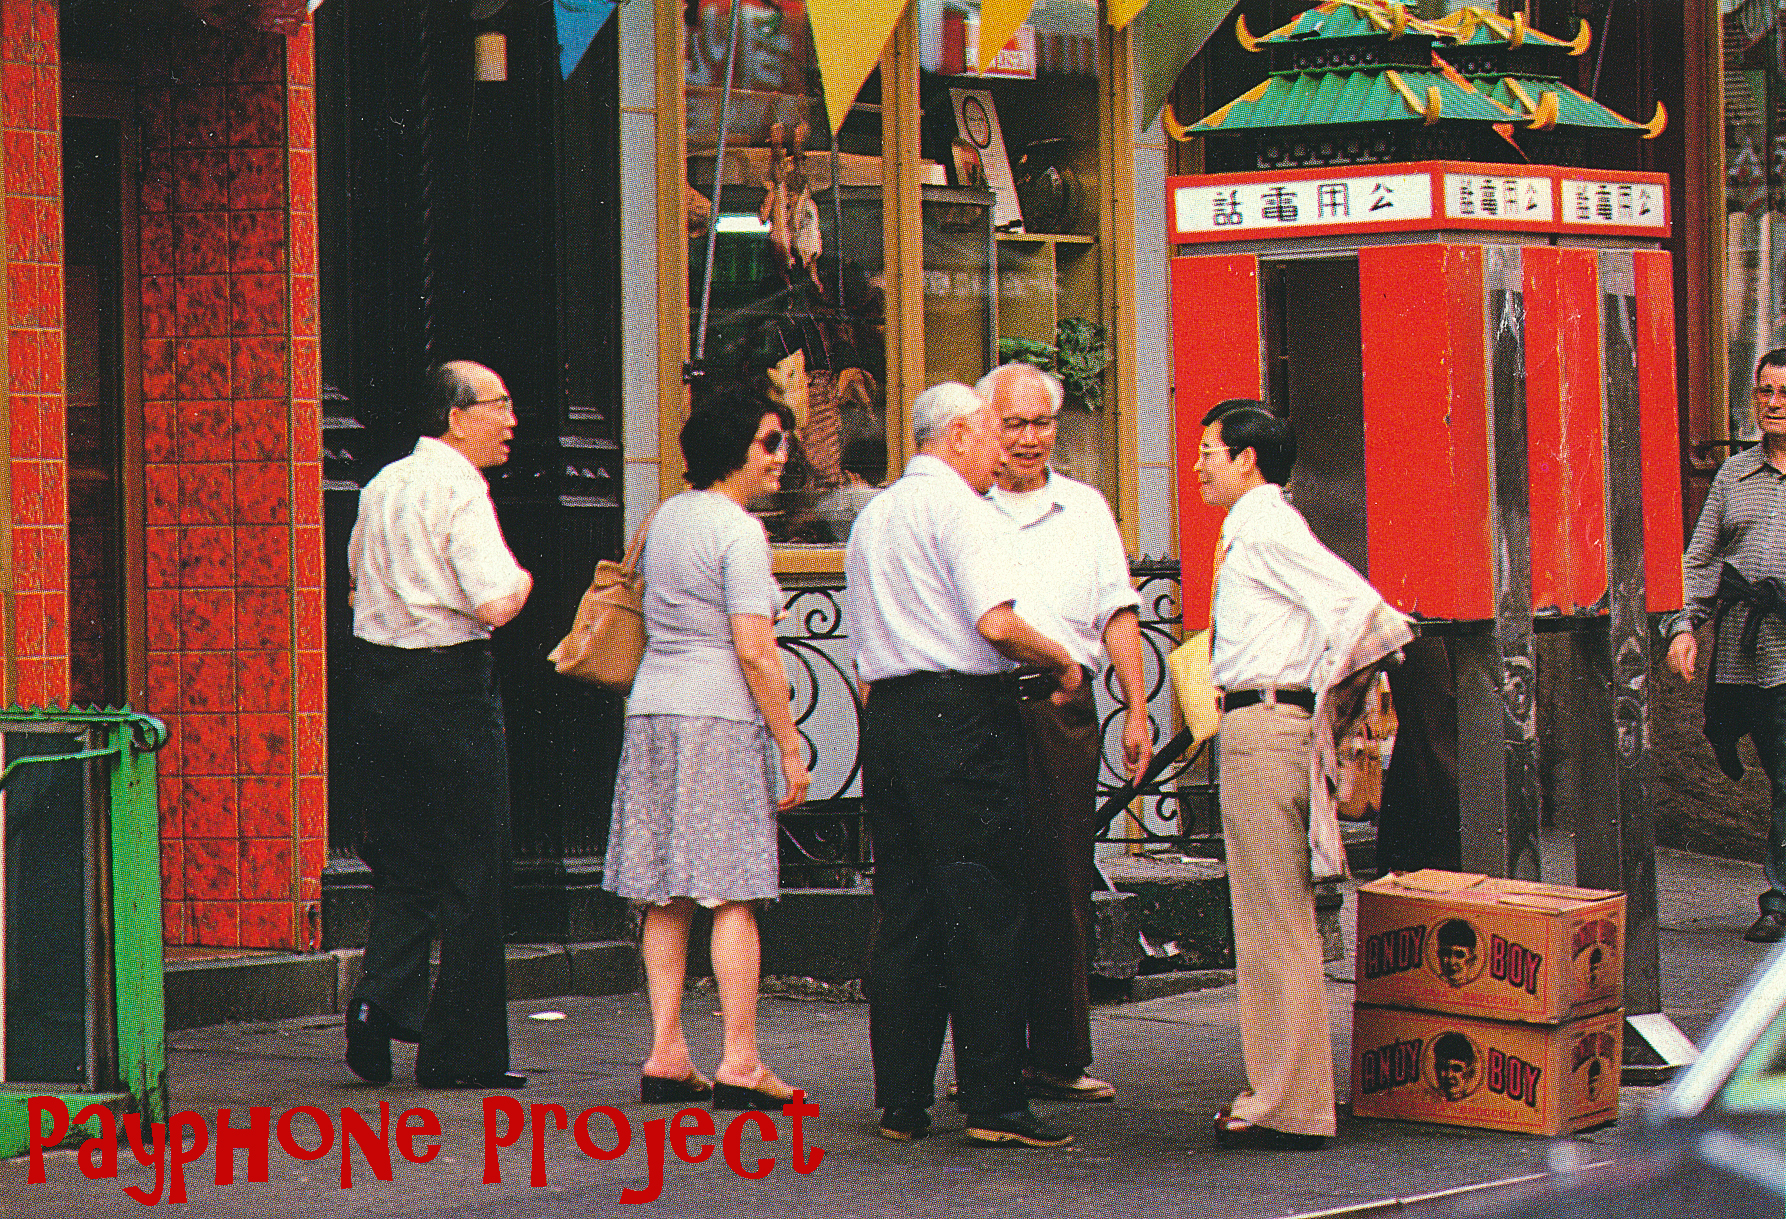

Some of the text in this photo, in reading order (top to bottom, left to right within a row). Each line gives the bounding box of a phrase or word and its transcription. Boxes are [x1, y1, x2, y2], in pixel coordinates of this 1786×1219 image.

[1365, 924, 1427, 980] ANDY
[1489, 933, 1543, 995] BOY
[1362, 1038, 1424, 1095] ANDY
[1487, 1047, 1542, 1108] BOY
